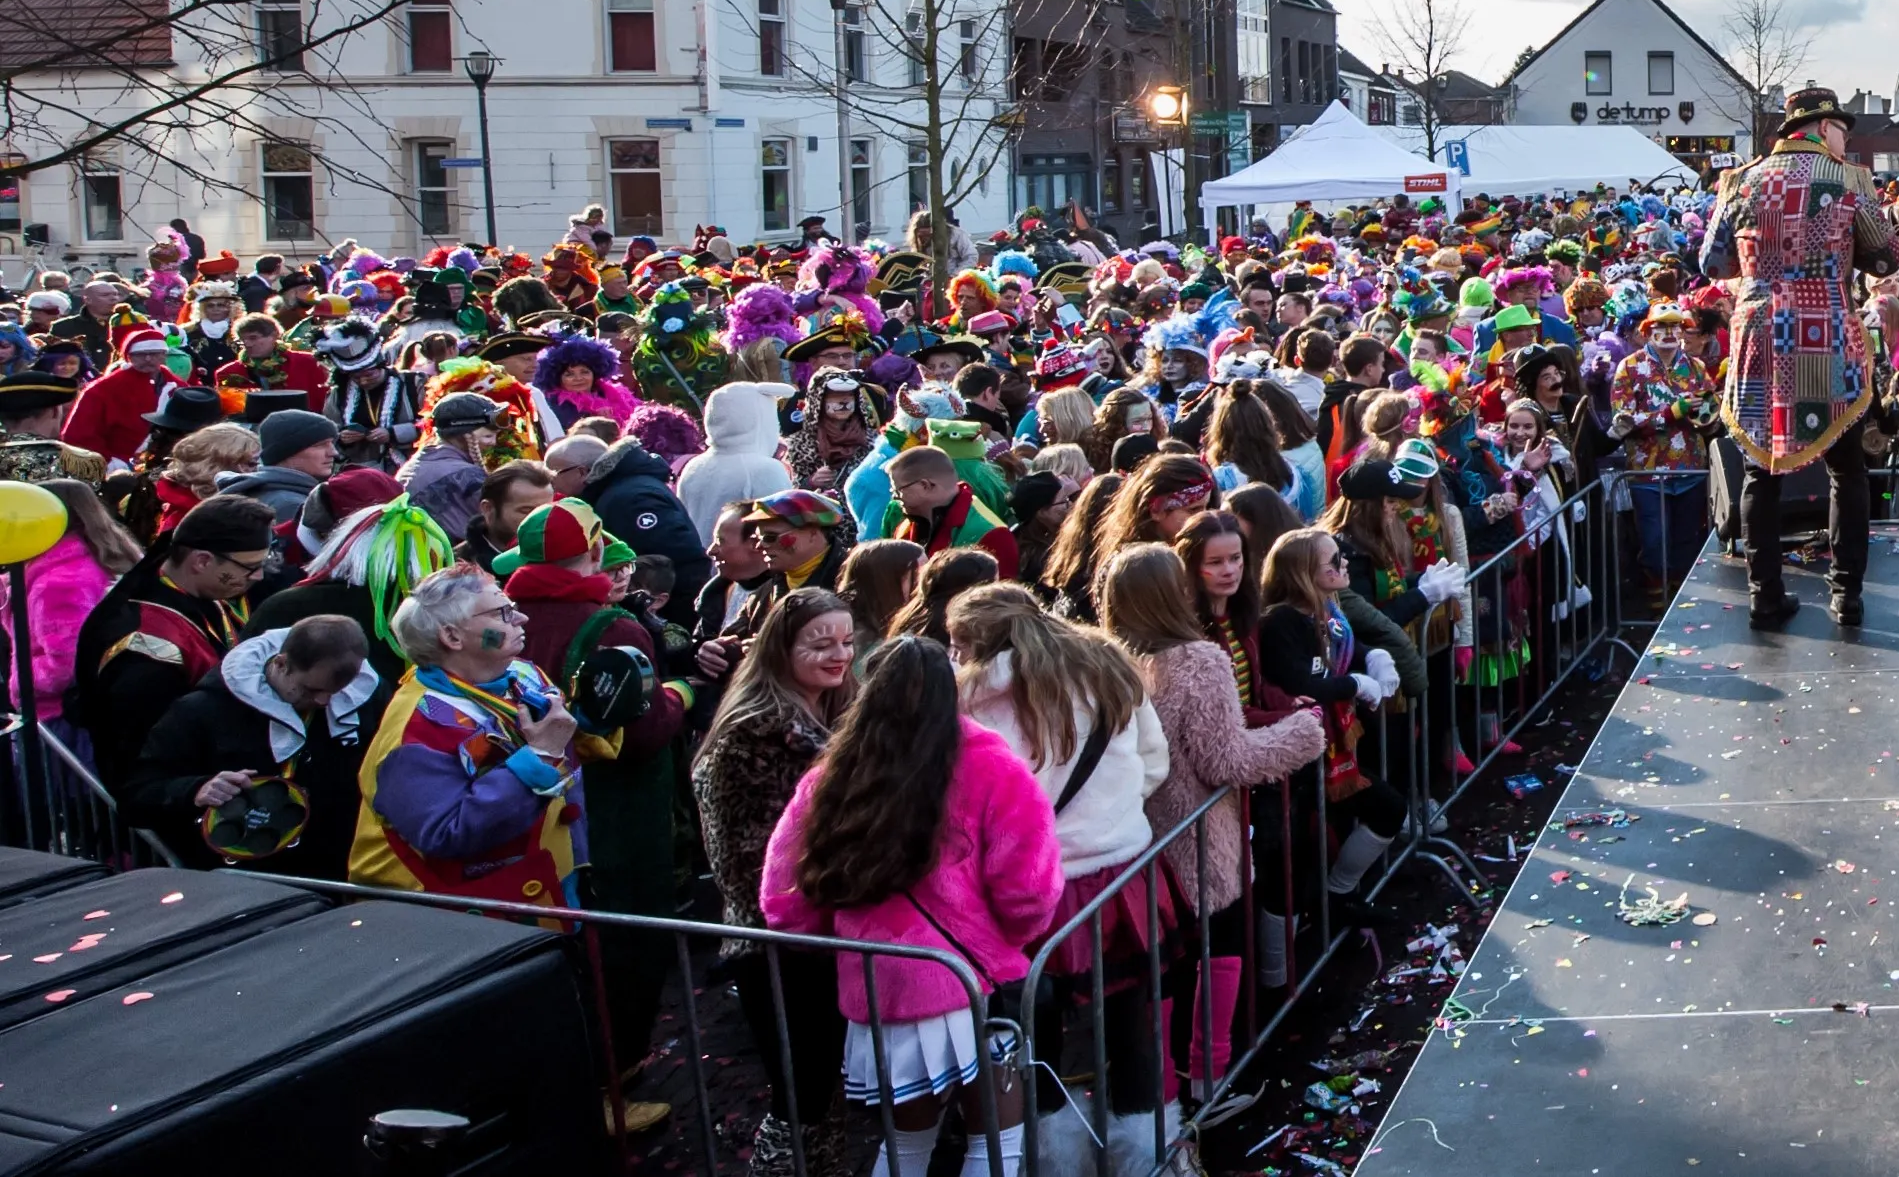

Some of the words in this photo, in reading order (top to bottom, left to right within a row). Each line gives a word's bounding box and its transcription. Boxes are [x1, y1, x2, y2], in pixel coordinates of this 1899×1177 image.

[1597, 101, 1621, 120] de
[1620, 101, 1670, 123] tump
[1450, 143, 1464, 162] P
[1408, 178, 1442, 187] STIHL
